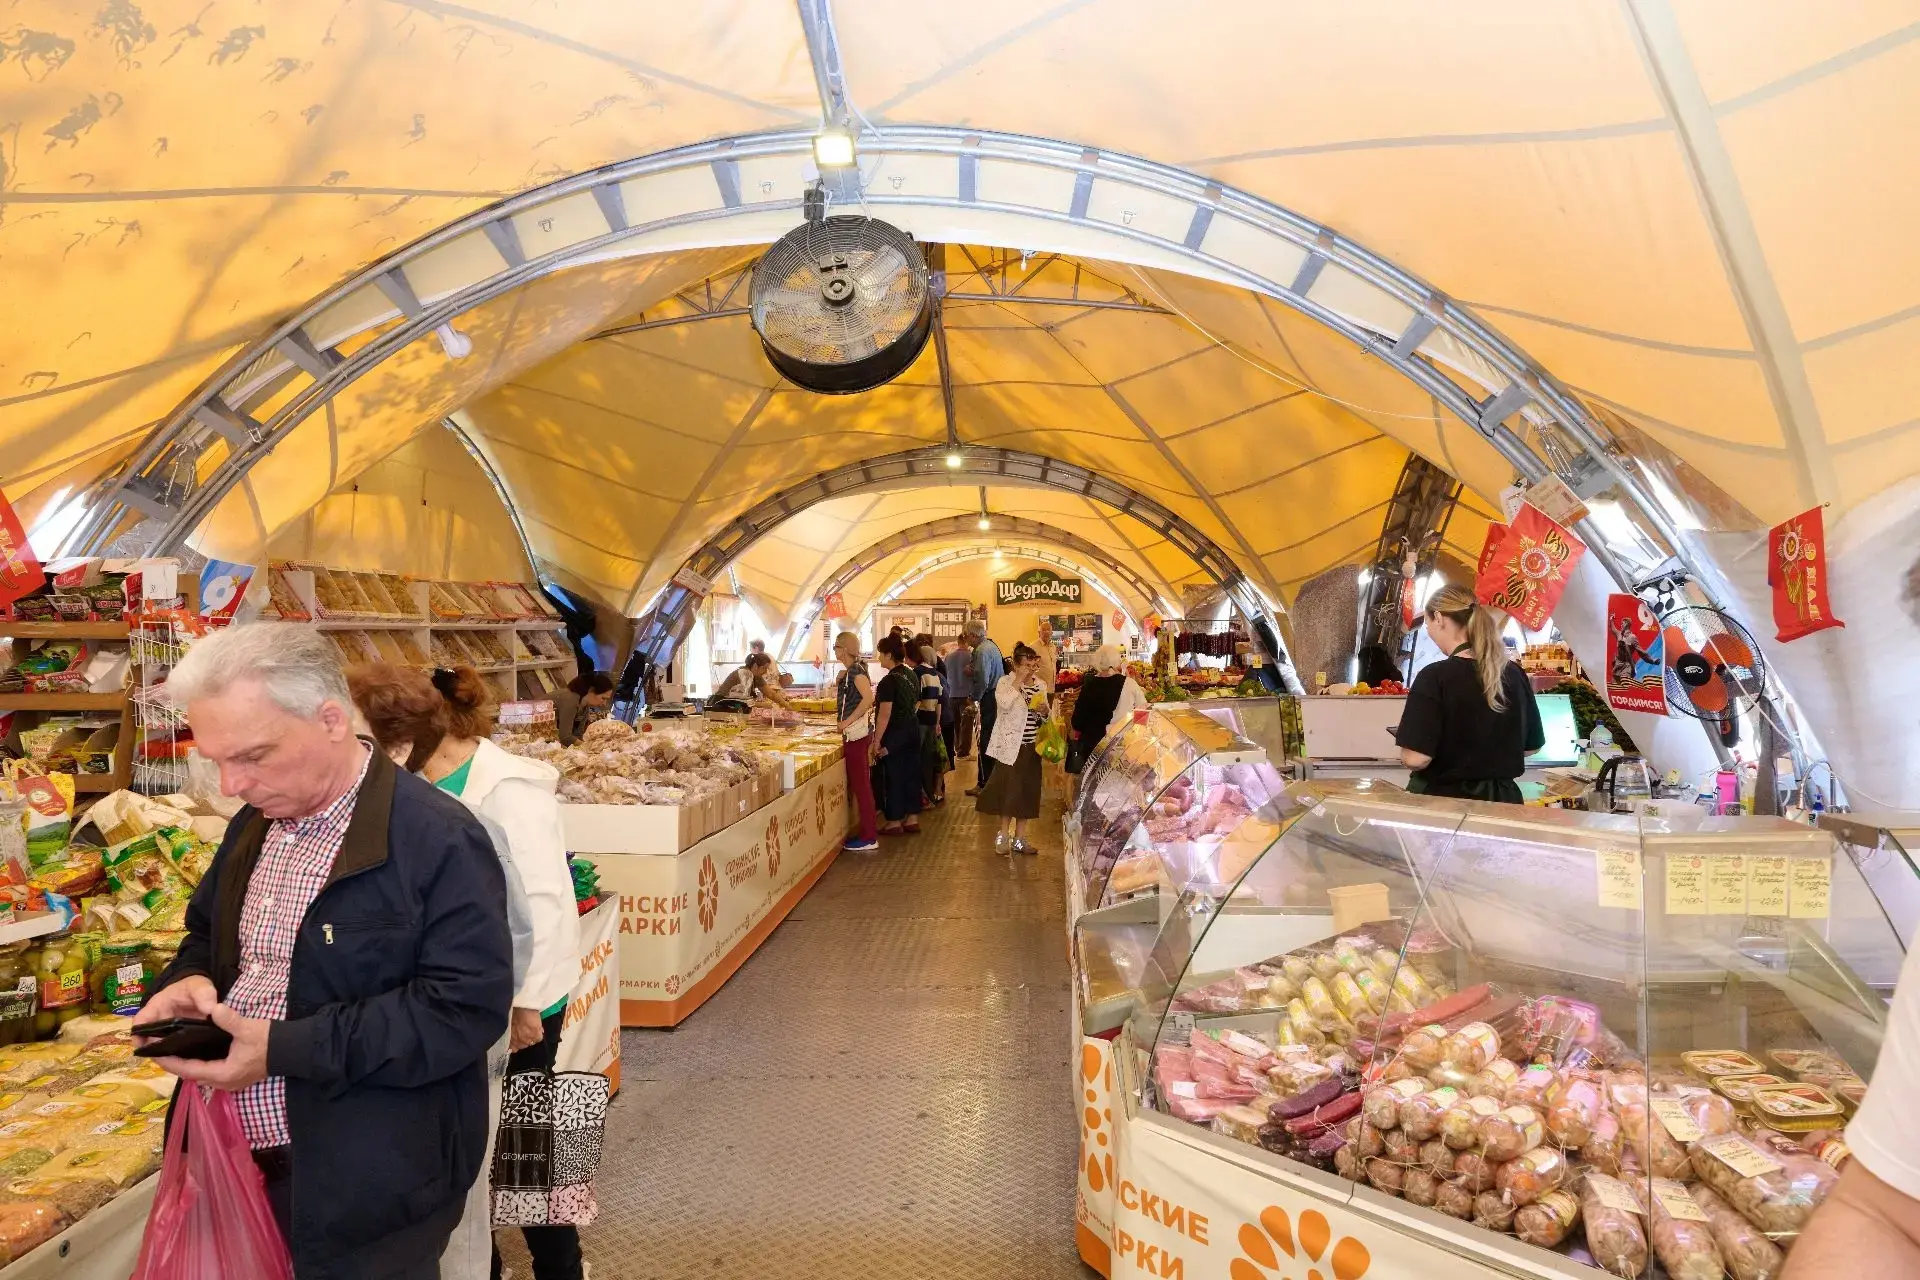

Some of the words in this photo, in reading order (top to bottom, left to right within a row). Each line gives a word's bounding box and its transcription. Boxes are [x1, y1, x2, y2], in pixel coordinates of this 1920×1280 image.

[1804, 542, 1816, 561] 9
[998, 580, 1080, 603] ЩедроДар
[1637, 602, 1654, 631] 9
[1611, 695, 1664, 710] ГОРДИМСЯ!
[63, 973, 81, 988] 260
[501, 1152, 547, 1162] GEOMETRIC
